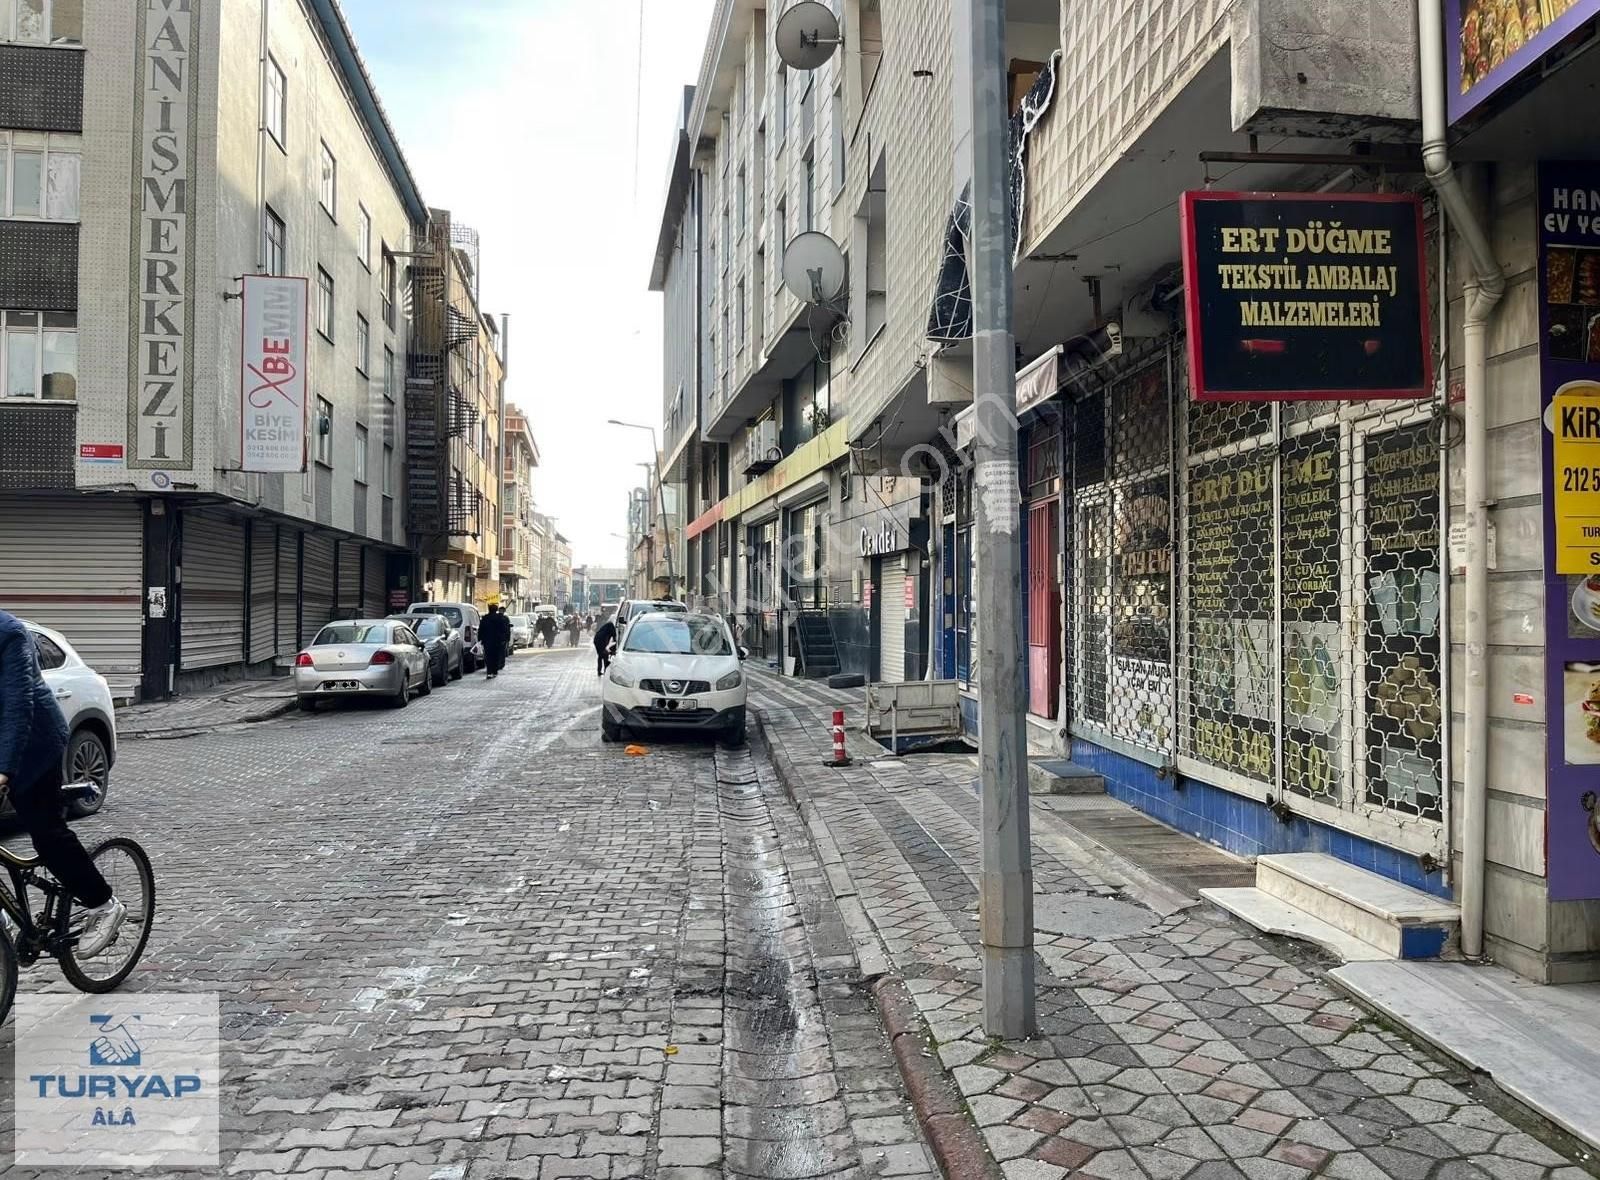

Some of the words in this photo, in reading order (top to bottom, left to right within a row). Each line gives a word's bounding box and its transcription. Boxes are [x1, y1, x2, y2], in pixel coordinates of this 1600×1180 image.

[1221, 227, 1280, 253] ERT
[1286, 221, 1392, 255] DÜĞME
[1218, 257, 1302, 290] TEKSTİL
[1306, 265, 1397, 298] AMBALAJ
[1240, 295, 1381, 327] MALZEMELERİ
[1563, 467, 1589, 492] 212
